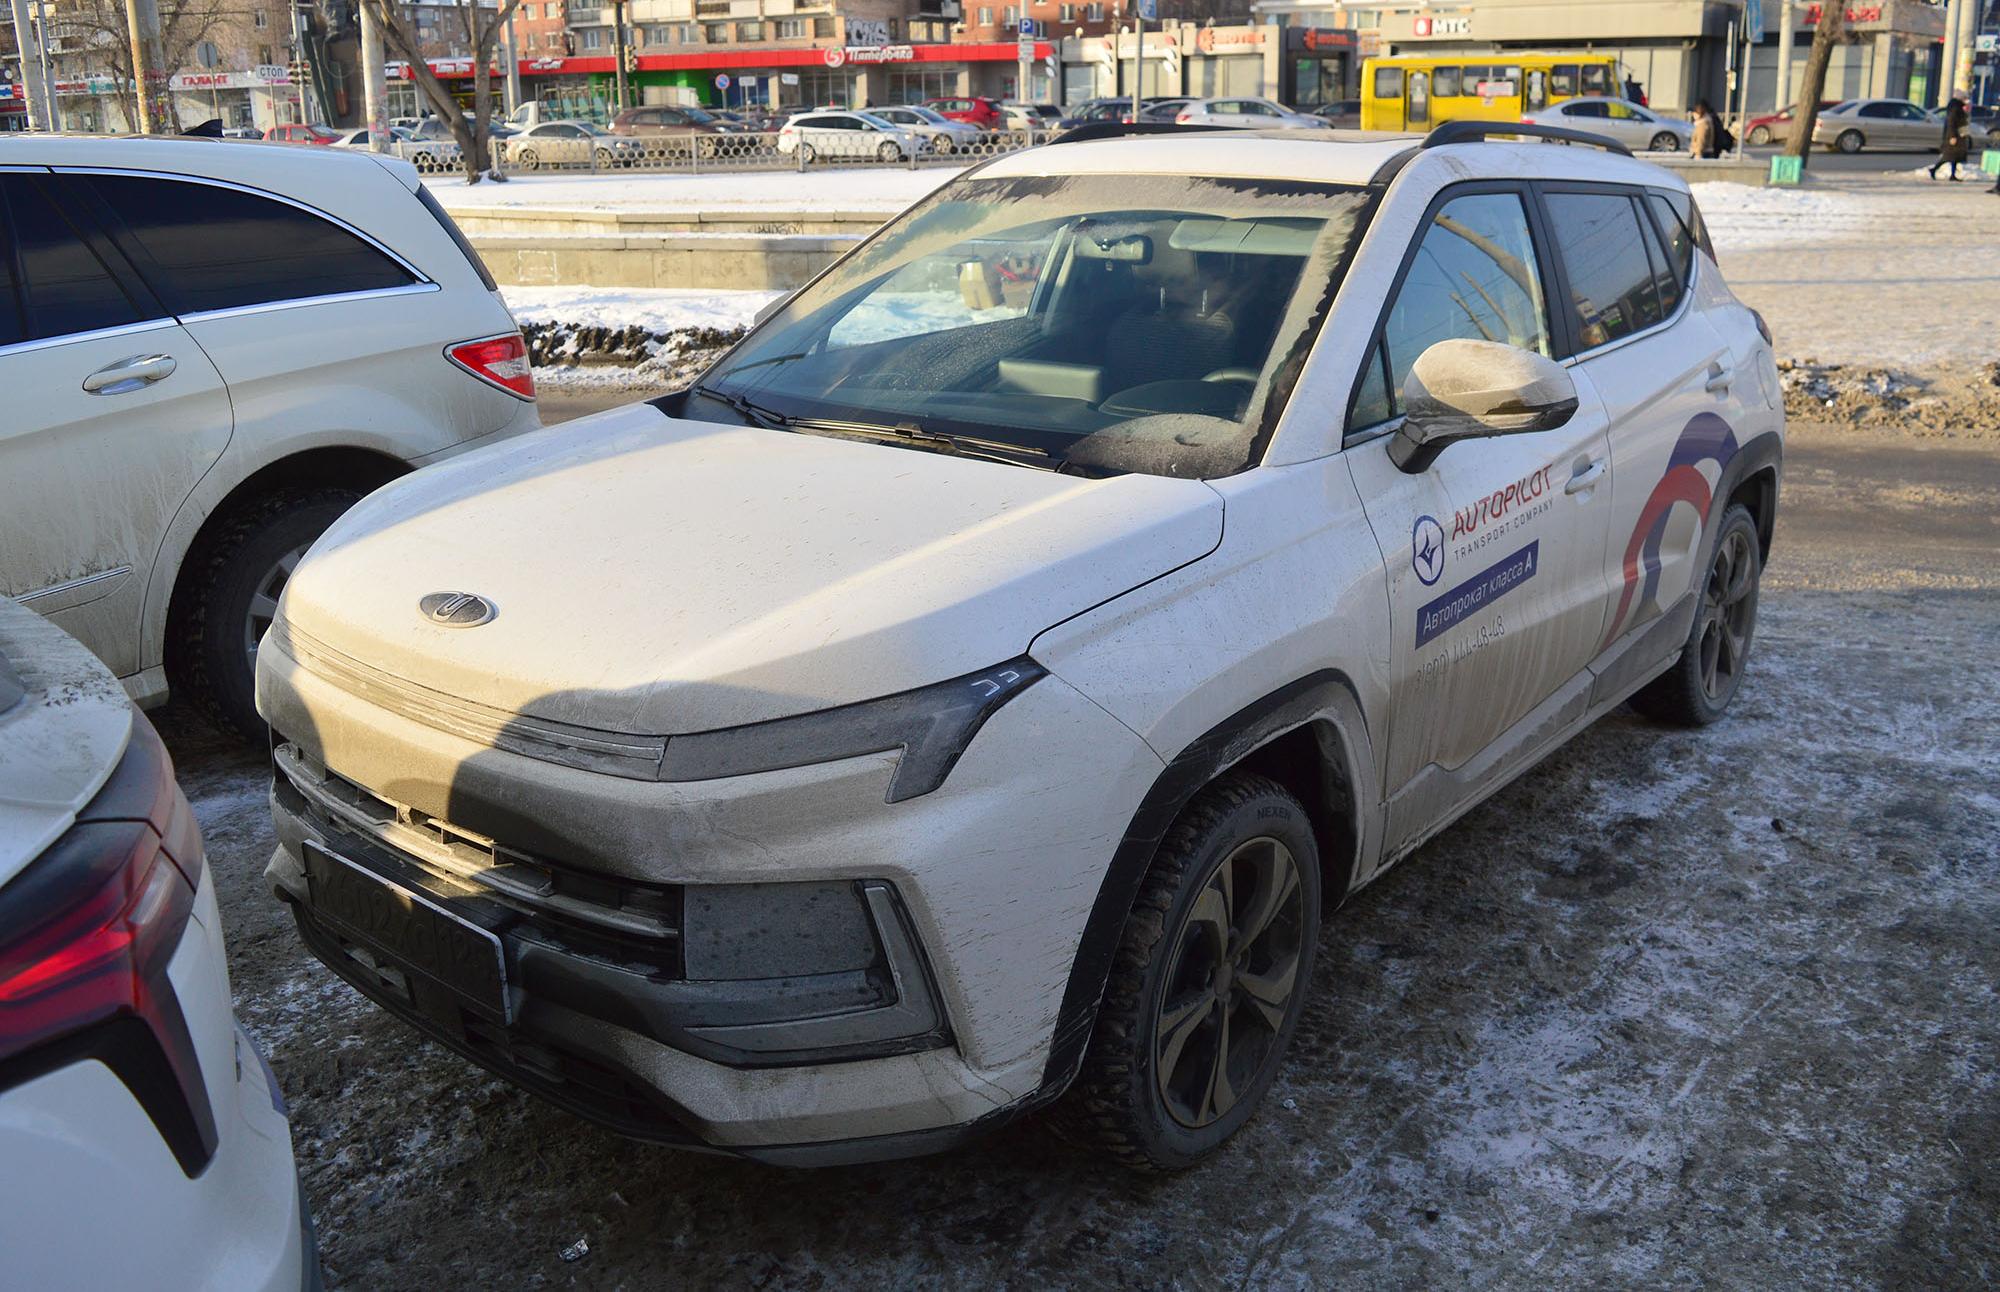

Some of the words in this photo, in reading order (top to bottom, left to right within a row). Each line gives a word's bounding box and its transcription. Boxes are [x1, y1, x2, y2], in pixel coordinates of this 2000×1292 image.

[260, 67, 283, 77] СТОП
[1452, 464, 1553, 541] AUTOPILOT
[1454, 521, 1510, 562] TRANSPORT
[1514, 497, 1555, 530] COMPANY
[1424, 584, 1488, 632] Автопрокат
[1489, 561, 1523, 593] класса
[1257, 806, 1291, 821] NEXEN
